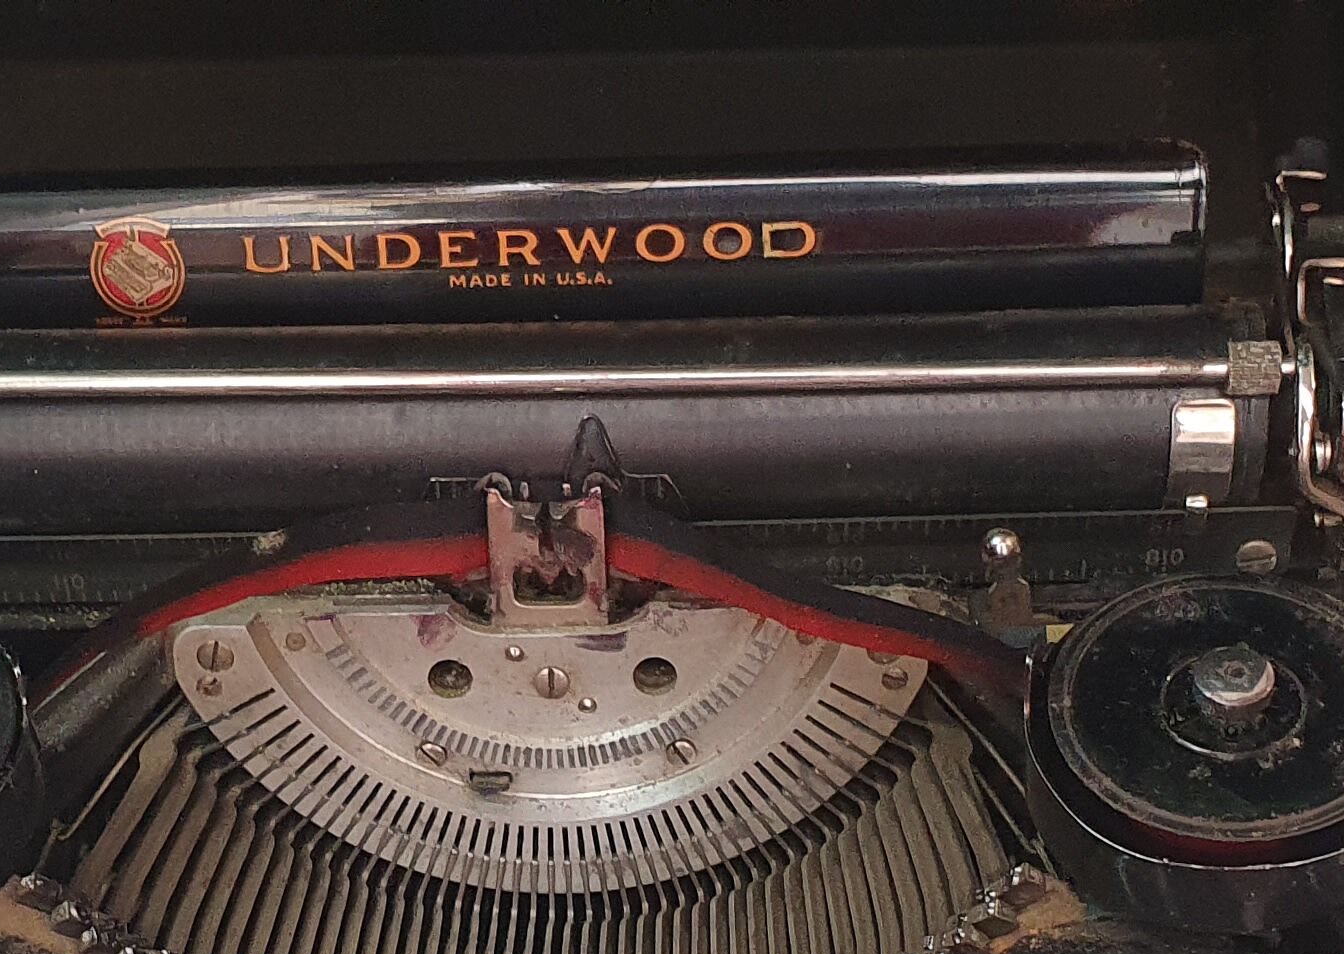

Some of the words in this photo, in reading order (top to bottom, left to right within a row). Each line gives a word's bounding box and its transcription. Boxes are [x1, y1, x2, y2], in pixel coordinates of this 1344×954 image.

[244, 221, 818, 272] UNDERWOOD
[449, 273, 512, 288] MADE
[524, 273, 546, 286] IN
[556, 271, 613, 286] U.S.A.
